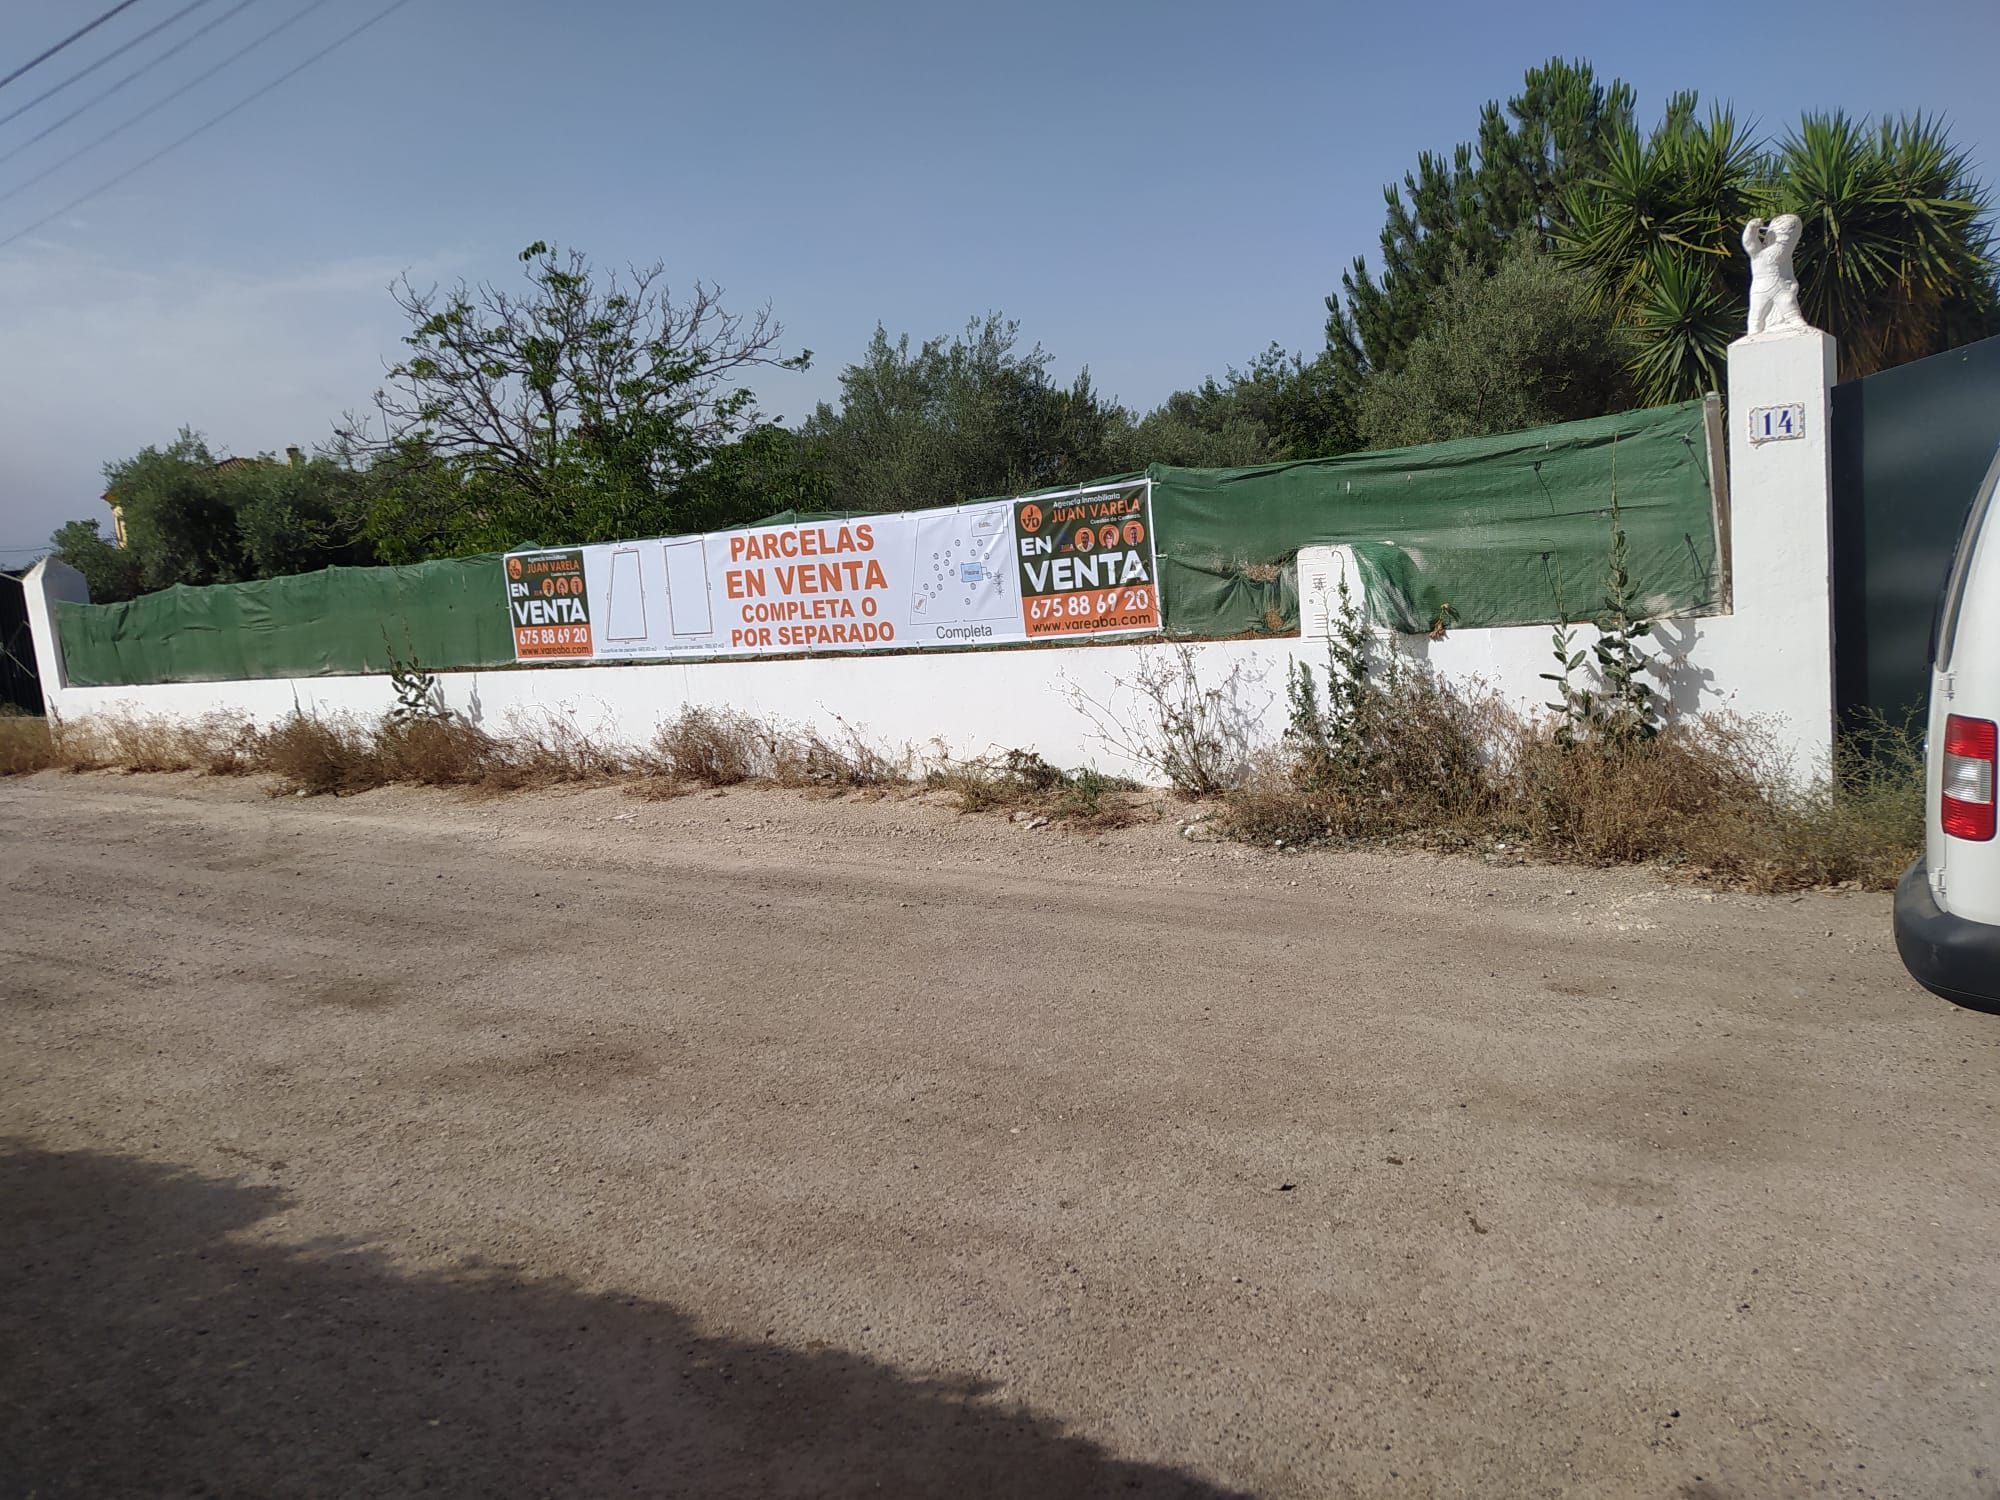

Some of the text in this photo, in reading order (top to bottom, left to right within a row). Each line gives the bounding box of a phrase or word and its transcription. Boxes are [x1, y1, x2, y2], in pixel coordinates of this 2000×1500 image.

[1763, 410, 1793, 435] 14
[1052, 505, 1086, 523] JUAN
[1089, 498, 1140, 517] VARELA
[1053, 492, 1121, 508] Agencia Inmobiliaria
[730, 524, 874, 562] PARCELAS
[1021, 535, 1052, 556] EN
[527, 561, 549, 574] JUAN
[550, 560, 580, 571] VARELA
[726, 559, 888, 599] EN VENTA
[1023, 550, 1149, 592] VENTA
[510, 583, 530, 597] EN
[513, 597, 588, 625] VENTA
[742, 597, 877, 623] COMPLETA O
[1030, 589, 1149, 619] 675 88 69 20
[731, 621, 895, 648] POR SEPARADO
[936, 625, 993, 640] Completa
[1032, 613, 1151, 632] www.vareaba.com
[520, 627, 588, 645] 675 88 69 20
